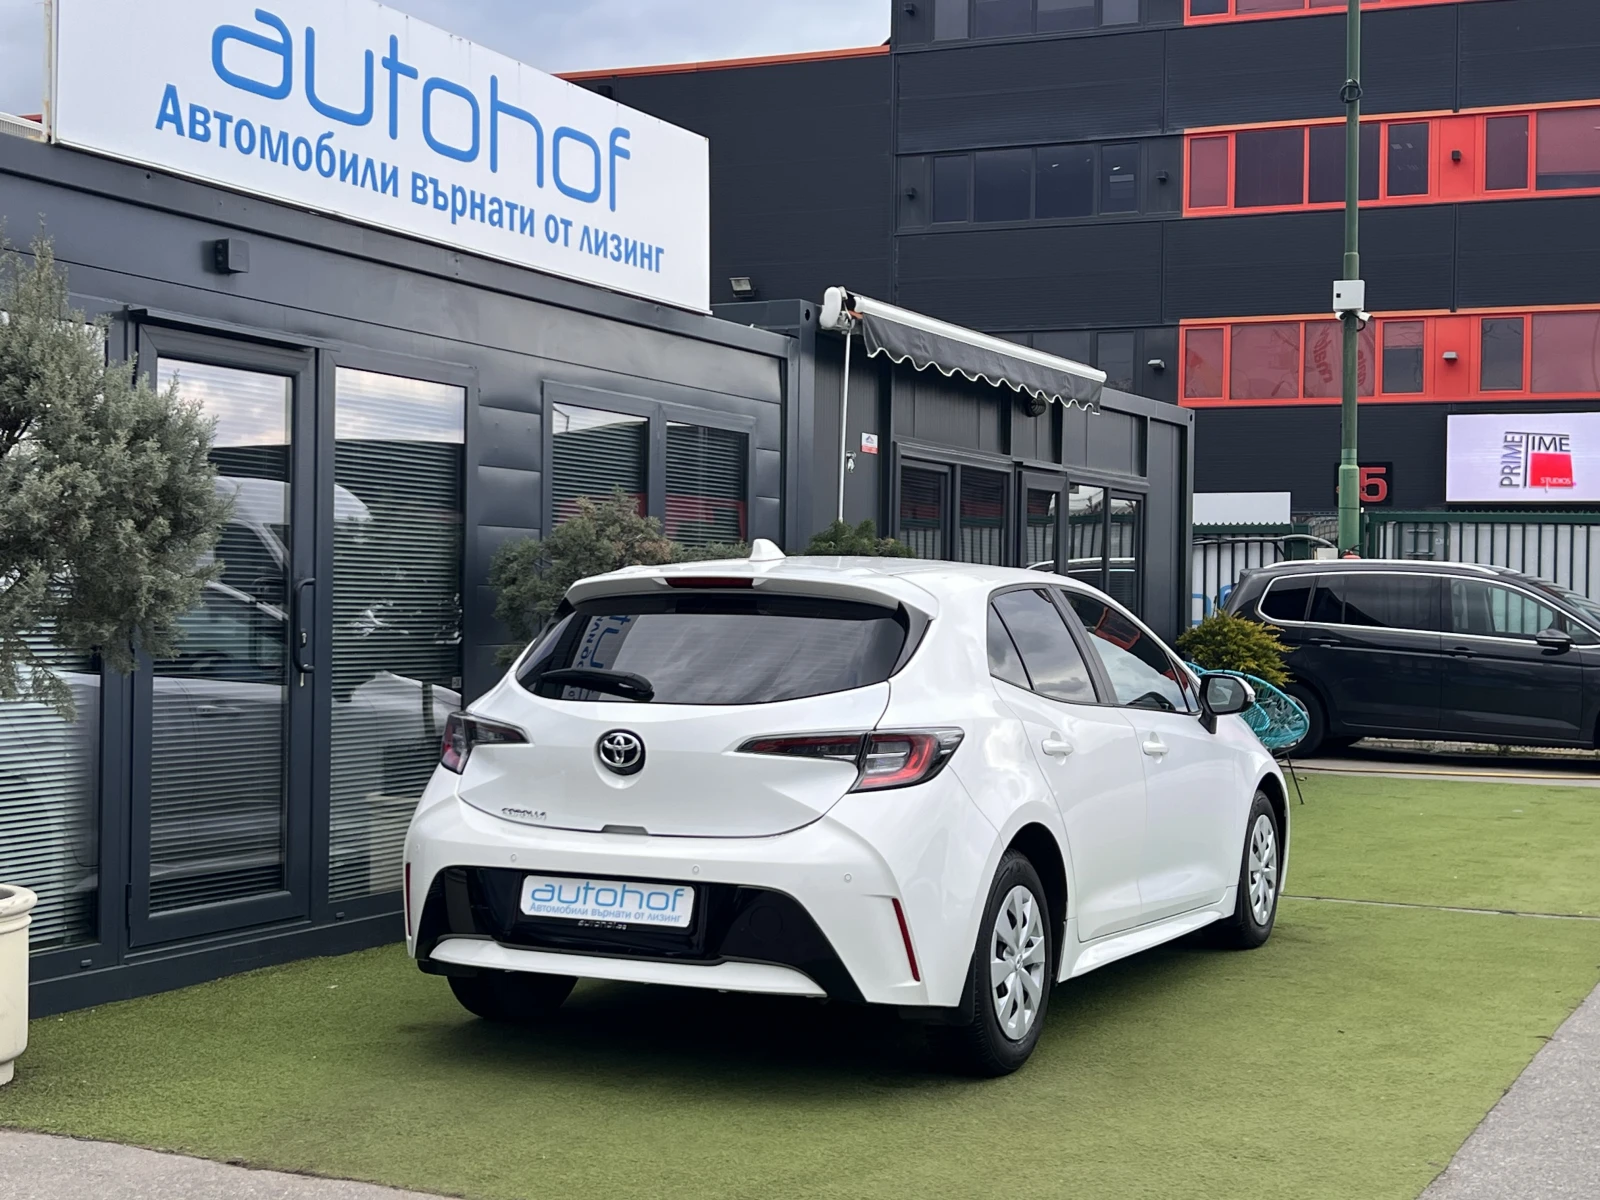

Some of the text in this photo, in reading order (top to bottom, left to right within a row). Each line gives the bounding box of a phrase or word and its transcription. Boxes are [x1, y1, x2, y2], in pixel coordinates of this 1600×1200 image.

[210, 8, 631, 212] autohof
[154, 83, 664, 273] Автомобили върнати от лизинг
[1499, 434, 1524, 488] PRIME
[1360, 467, 1388, 503] 5
[1540, 476, 1572, 486] STUDIOS
[529, 901, 683, 923] Автомобили върнати от лизинг
[531, 881, 685, 912] autohof
